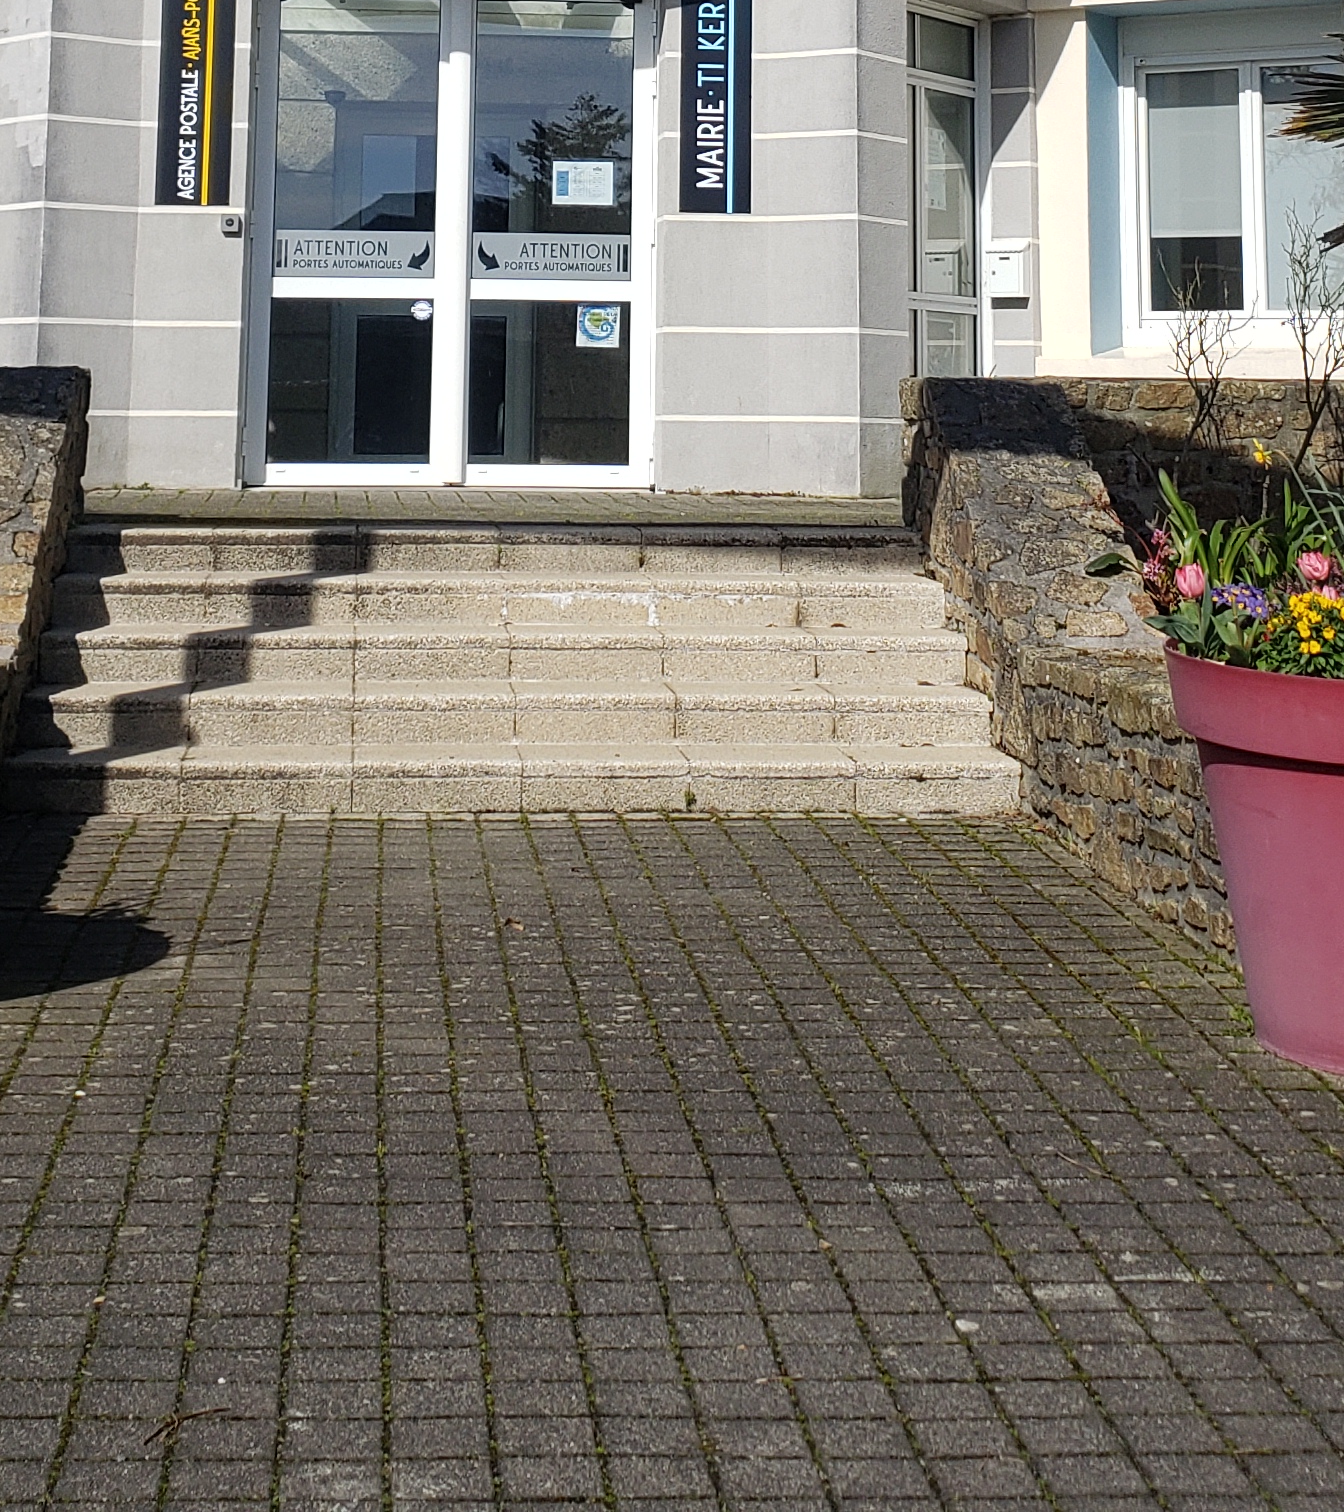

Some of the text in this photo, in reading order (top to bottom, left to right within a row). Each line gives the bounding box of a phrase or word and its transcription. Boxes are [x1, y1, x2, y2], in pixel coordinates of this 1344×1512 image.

[179, 69, 199, 136] POSTALE
[696, 2, 726, 188] MAIRIE TI KER
[176, 138, 197, 201] AGENCE
[293, 239, 388, 257] ATTENTION
[519, 242, 612, 260] ATTENTION
[292, 258, 403, 270] PORTES AUTOMATIQUES
[504, 260, 612, 273] PORTES AUTOMATIQUES
